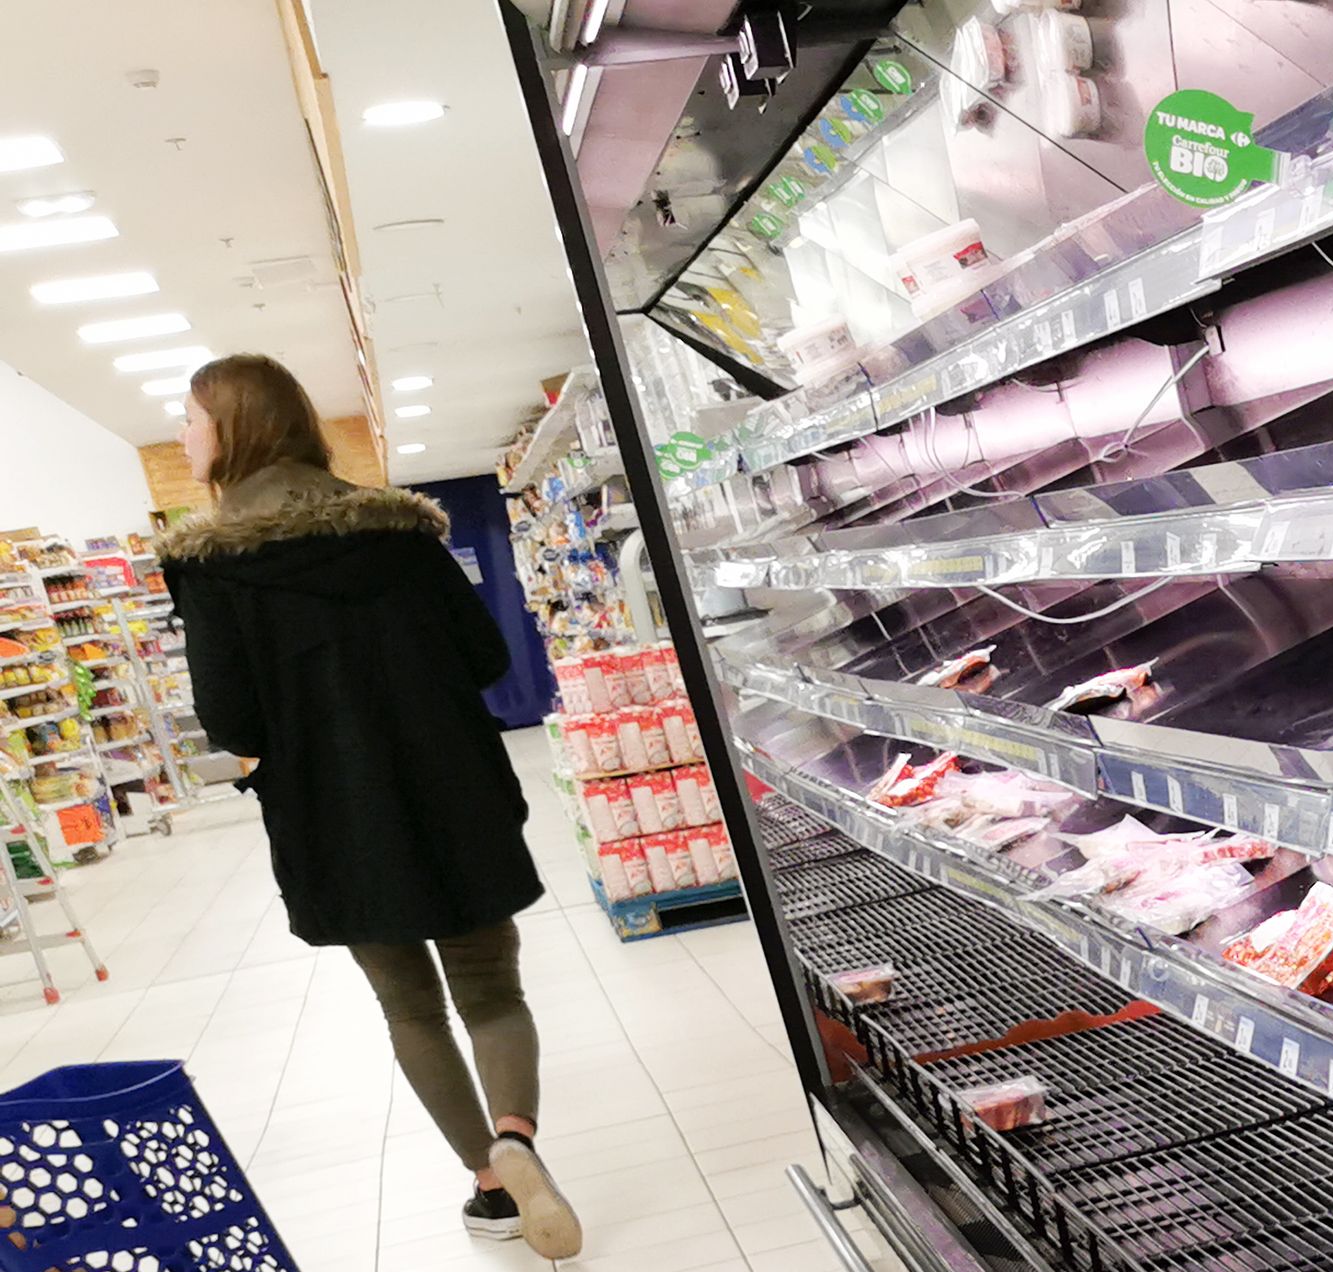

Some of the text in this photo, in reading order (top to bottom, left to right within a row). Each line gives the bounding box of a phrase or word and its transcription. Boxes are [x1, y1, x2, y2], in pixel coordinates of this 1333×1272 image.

[1156, 111, 1226, 141] TU MARCA
[1171, 134, 1230, 158] Carrefour
[1170, 146, 1229, 182] BIO
